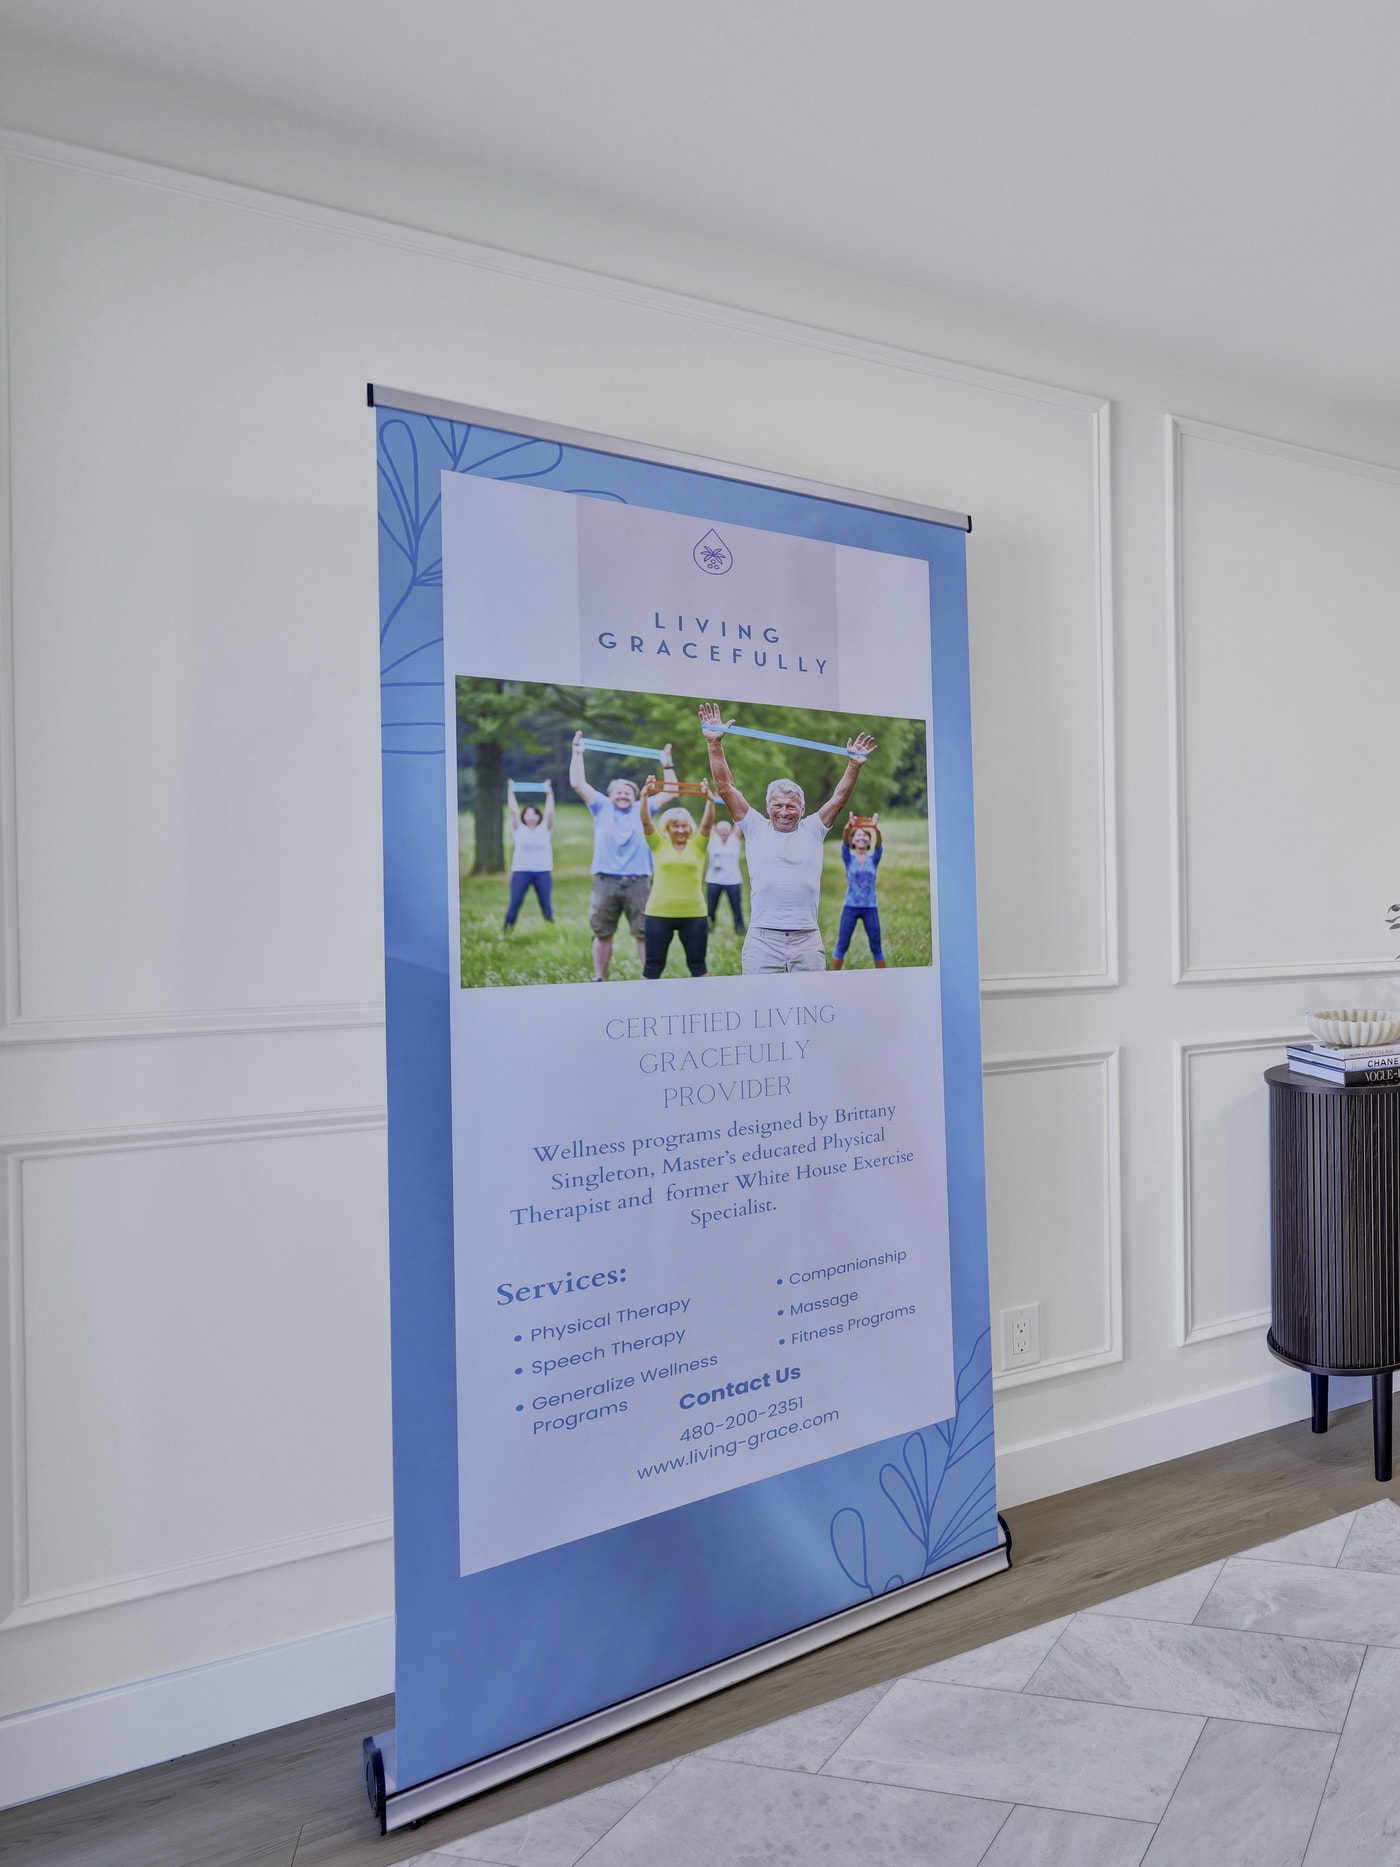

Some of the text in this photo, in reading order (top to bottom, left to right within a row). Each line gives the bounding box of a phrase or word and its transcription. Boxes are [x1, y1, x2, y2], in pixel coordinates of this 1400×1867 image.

[655, 612, 779, 643] LIVING
[598, 632, 827, 674] GRACEFULLY
[605, 1004, 836, 1040] CERTIFIED LIVING
[639, 1039, 811, 1074] GRACEFULLY
[663, 1075, 792, 1109] PROVIDER
[532, 1104, 897, 1163] Wellness programs designed by Brittany
[551, 1127, 886, 1192] Singleton, Master’s educated Physical
[510, 1149, 914, 1226] Therapist and former White House Exercise
[690, 1200, 777, 1228] Specialist.
[497, 1267, 627, 1306] Services:
[789, 1248, 908, 1286] Companionship
[530, 1298, 692, 1342] Physical Therapy
[790, 1291, 859, 1316] Massage
[791, 1305, 917, 1345] Fitness Programs
[531, 1328, 687, 1376] Speech Therapy
[532, 1354, 719, 1411] Generalize Wellness
[679, 1366, 802, 1410] Contact Us
[533, 1400, 628, 1435] Programs
[679, 1396, 805, 1442] 480-200-2351
[637, 1407, 840, 1480] www.living-grace.com
